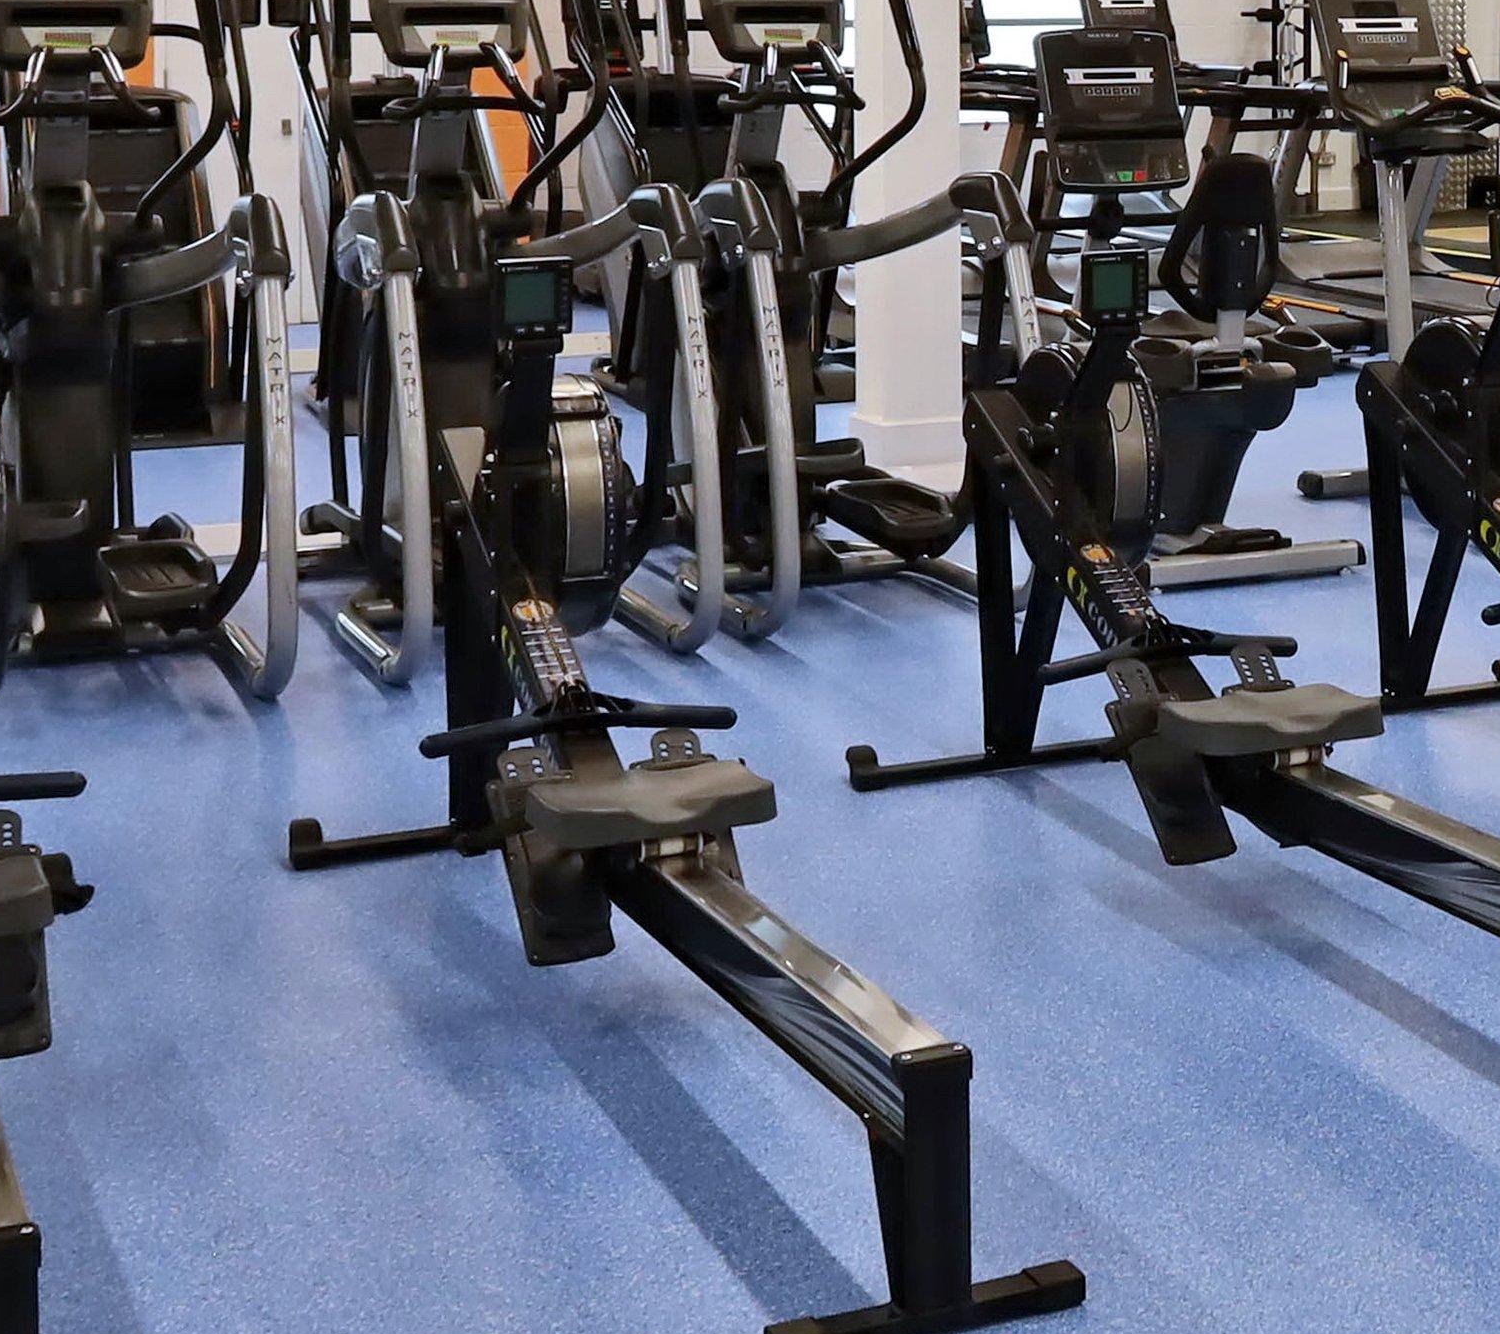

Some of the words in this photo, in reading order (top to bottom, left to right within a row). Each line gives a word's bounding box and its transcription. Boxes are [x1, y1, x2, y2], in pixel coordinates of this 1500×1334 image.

[687, 315, 708, 399] MATRIX
[762, 306, 785, 388] MATRIX
[1020, 294, 1038, 348] MATR
[265, 335, 286, 425] MATRIX
[398, 331, 419, 419] MATRIX
